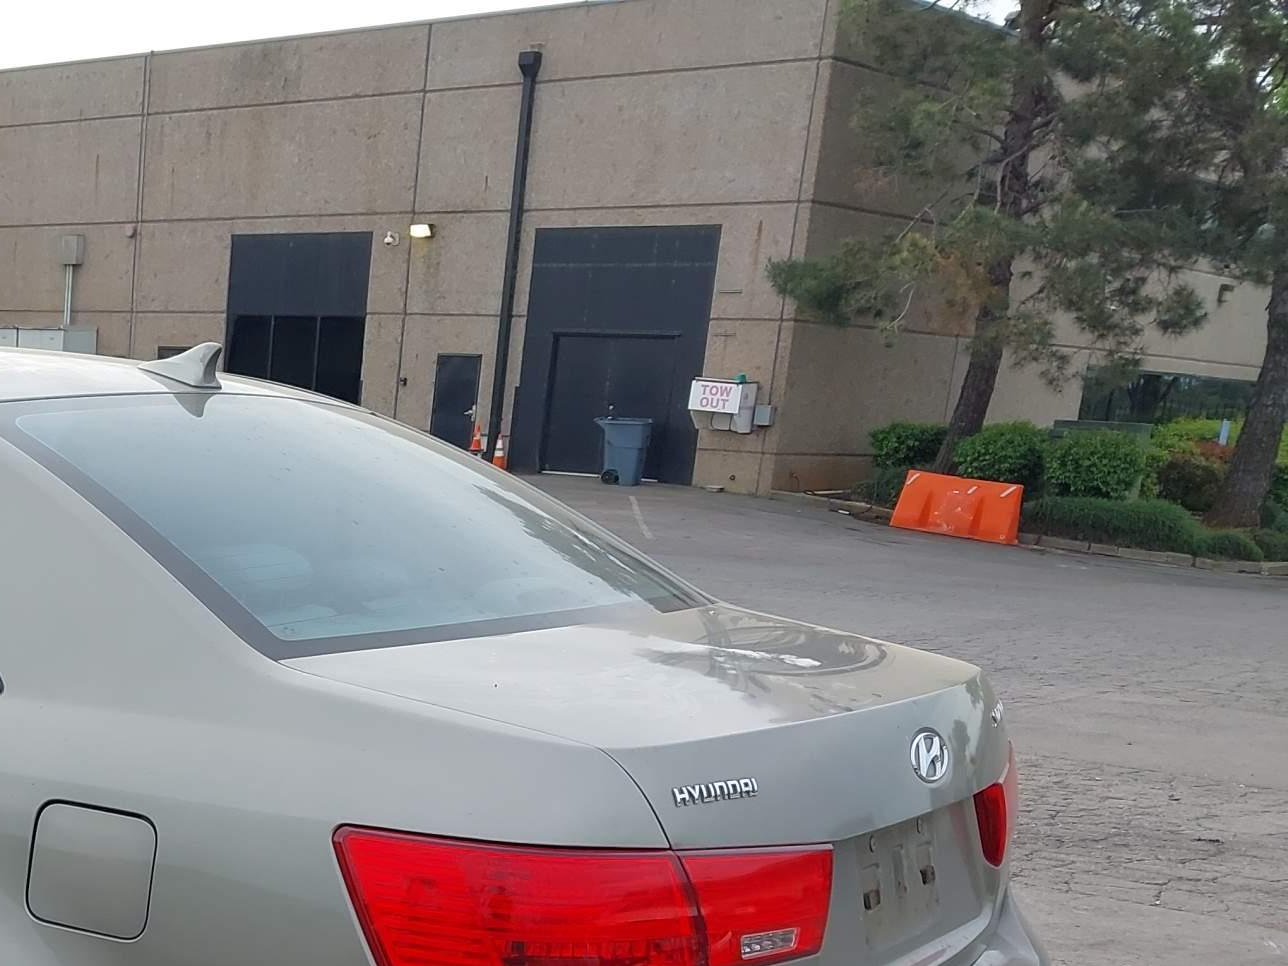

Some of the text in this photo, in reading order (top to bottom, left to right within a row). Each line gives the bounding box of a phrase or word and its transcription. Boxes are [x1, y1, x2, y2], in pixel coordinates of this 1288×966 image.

[701, 385, 732, 397] TOW
[700, 397, 729, 410] OUT
[672, 777, 758, 806] HYUNDAI
